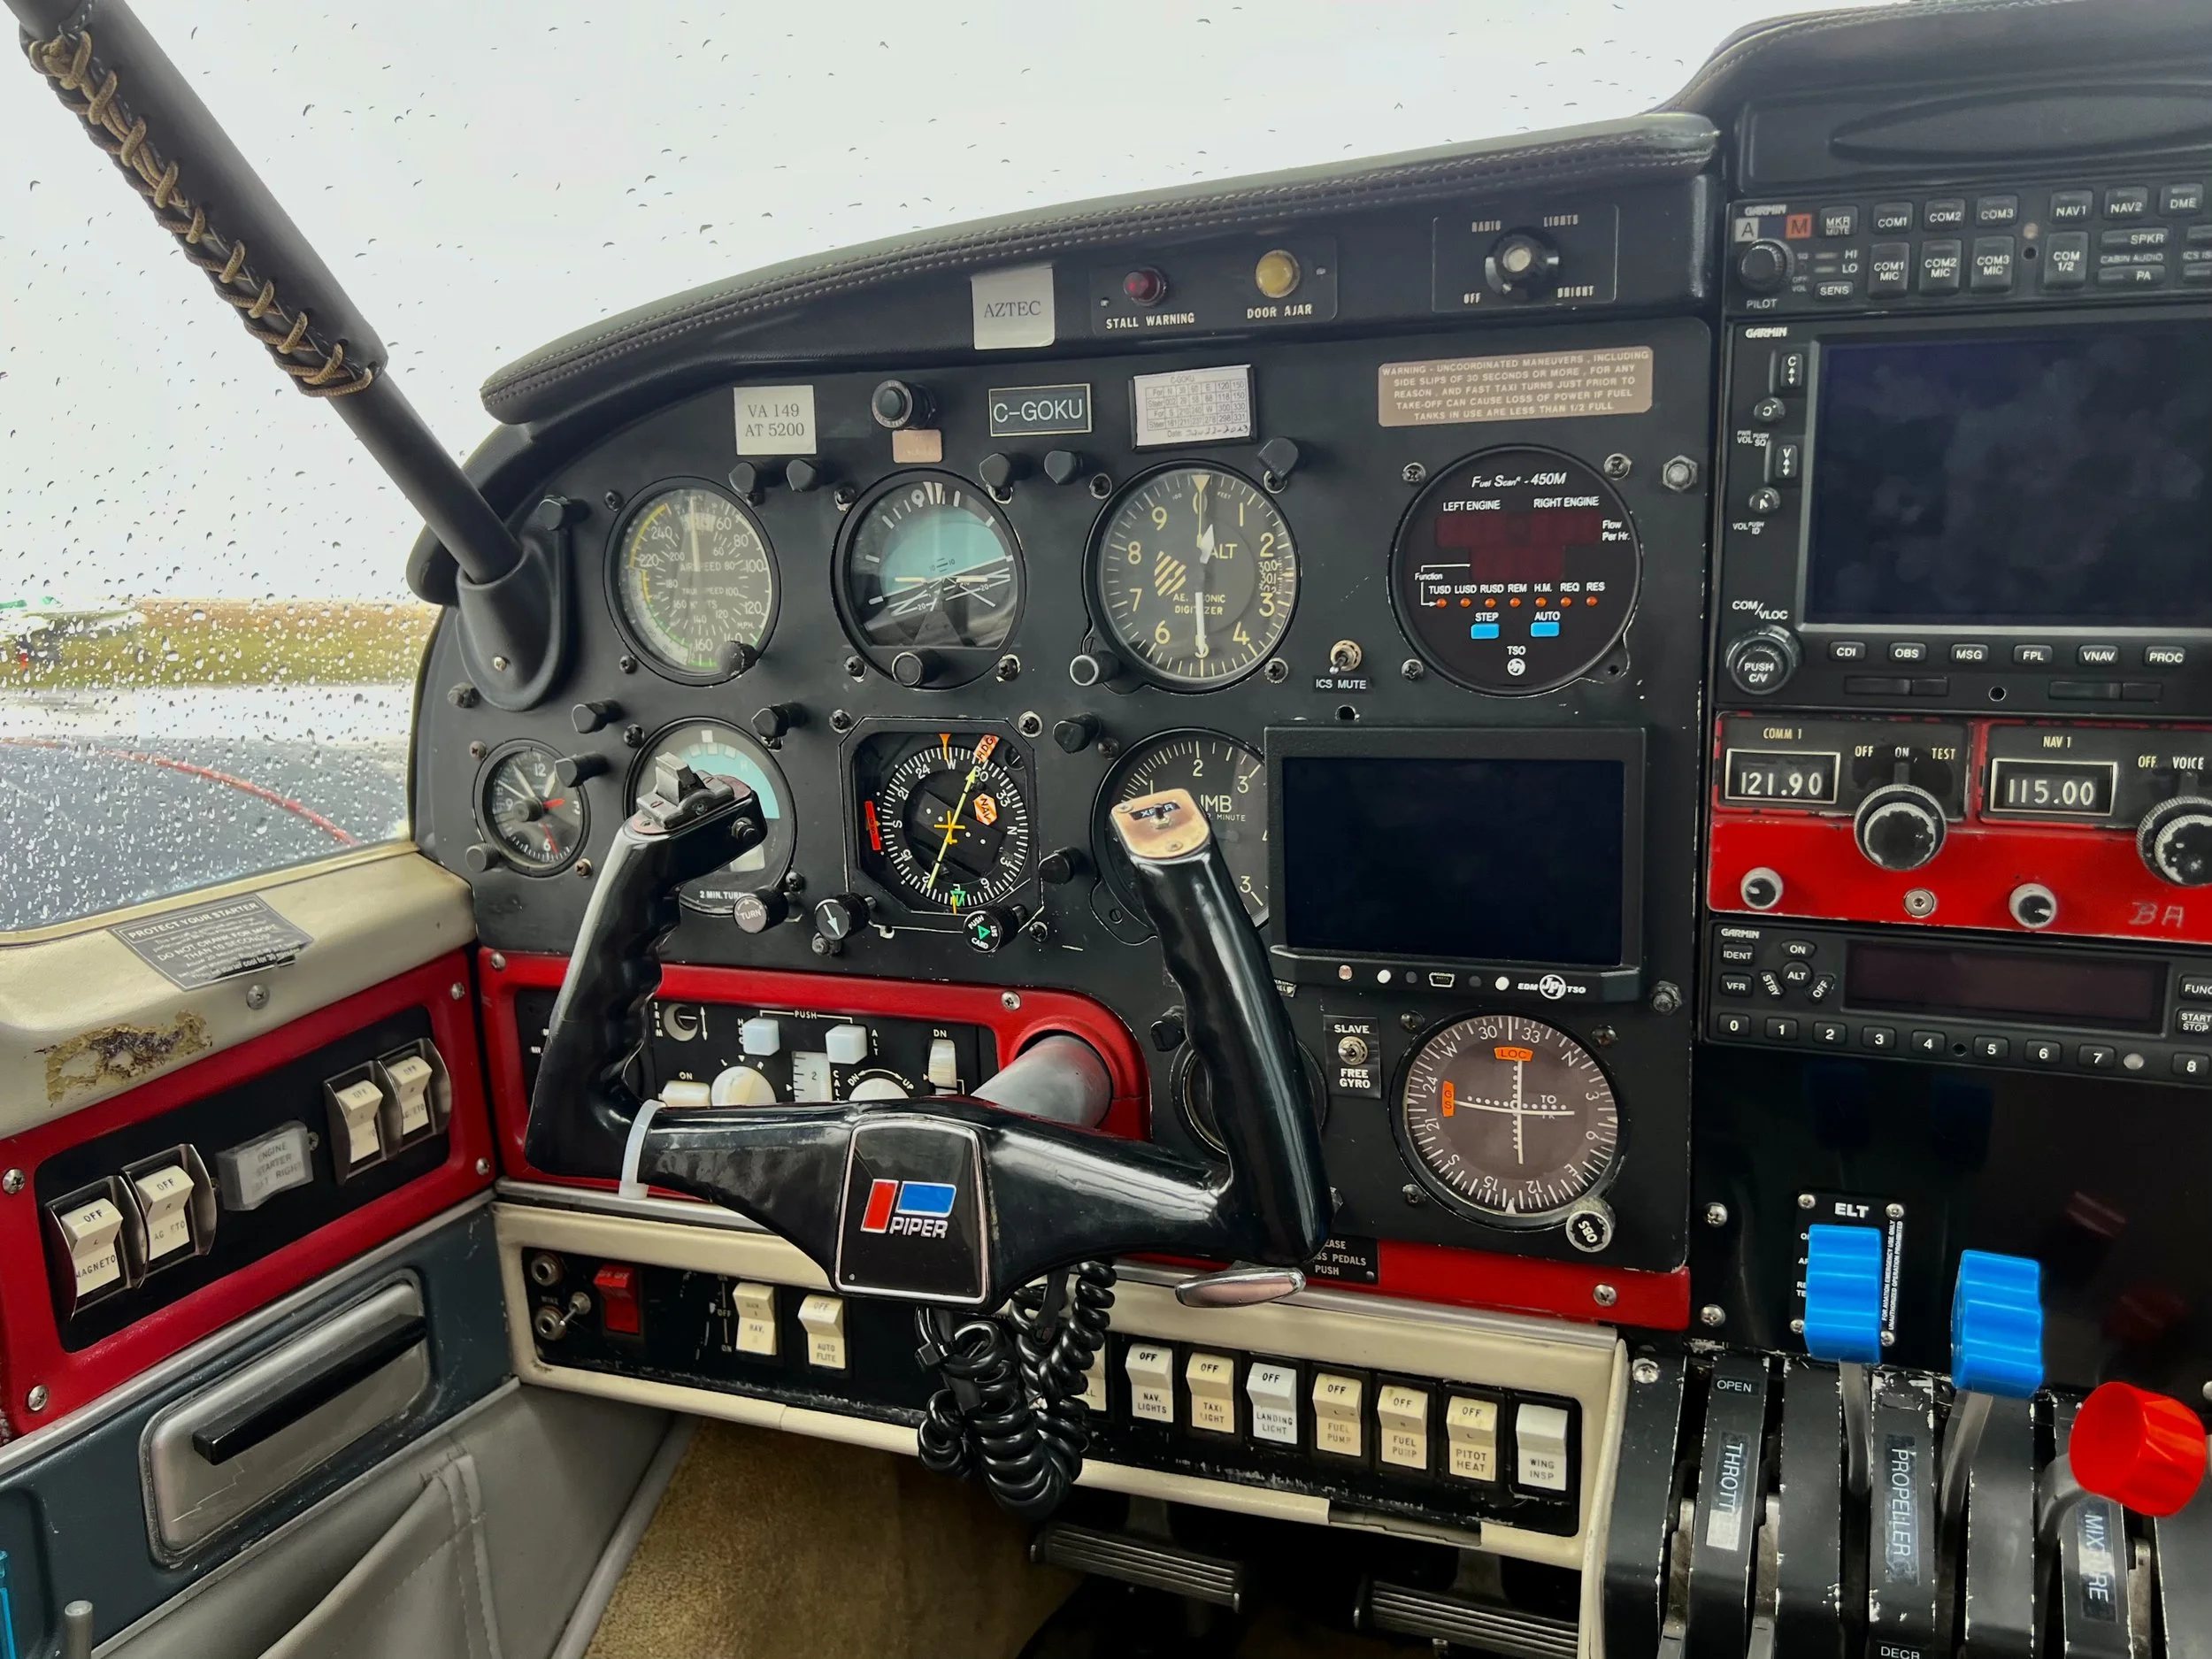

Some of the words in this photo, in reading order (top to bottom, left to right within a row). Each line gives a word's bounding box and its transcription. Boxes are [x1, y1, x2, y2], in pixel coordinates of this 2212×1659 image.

[2110, 202, 2142, 213] NAV2
[2170, 197, 2196, 209] DME
[1981, 209, 2014, 220] COM3
[2055, 203, 2087, 218] NAV1
[1544, 215, 1578, 227] LIGHTS
[1878, 217, 1908, 227] COM1
[1930, 211, 1962, 222] COM2
[1977, 255, 2009, 265] COM3
[2054, 250, 2080, 261] COM
[1874, 262, 1904, 272] COM1
[1924, 257, 1957, 268] COM2
[1931, 268, 1950, 278] MIC
[1983, 265, 2003, 275] MIC
[1879, 271, 1900, 281] MIC
[1820, 286, 1849, 296] SENS
[1463, 293, 1481, 303] OFF
[1747, 298, 1777, 309] PILOT
[984, 301, 1041, 318] AZTEC
[1247, 306, 1277, 319] DOOR
[1284, 304, 1312, 317] AJAR
[1106, 318, 1139, 329] STALL
[1146, 312, 1194, 326] WARNING
[1746, 327, 1787, 338] GARMIN
[1382, 365, 1426, 375] WARNING
[1594, 351, 1649, 362] INCLUDING
[1419, 376, 1446, 385] SLIPS
[1482, 371, 1529, 382] SECONDS
[1532, 370, 1547, 379] OR
[1550, 367, 1579, 377] MORE
[1590, 365, 1610, 375] FOR
[1615, 364, 1635, 373] ANY
[1394, 389, 1432, 398] REASON
[1495, 383, 1517, 393] TAXI
[1522, 381, 1554, 391] TURNS
[1557, 380, 1582, 388] JUST
[1586, 378, 1617, 387] PRIOR
[1621, 376, 1635, 385] TO
[1396, 400, 1443, 411] TAKE-OFF
[1470, 396, 1502, 405] CAUSE
[1506, 394, 1532, 403] LOSS
[1554, 391, 1590, 401] POWER
[1608, 389, 1632, 398] FUEL
[747, 404, 767, 418] VA
[773, 403, 799, 417] 149
[994, 399, 1082, 423] C-GOKU
[1415, 411, 1445, 421] TANKS
[1486, 408, 1506, 417] ARE
[1509, 405, 1535, 416] LESS
[1540, 404, 1566, 414] THAN
[1588, 403, 1614, 411] FULL
[745, 424, 764, 436] AT
[768, 423, 804, 436] 5200
[1471, 476, 1491, 488] Fuel
[1443, 502, 1463, 511] LEFT
[1466, 500, 1501, 510] ENGINE
[1533, 497, 1562, 508] RIGHT
[1564, 496, 1599, 507] ENGINE
[1602, 520, 1621, 529] Flow
[1602, 532, 1617, 541] Per
[1455, 585, 1477, 594] LUSD
[1480, 584, 1504, 593] RUSD
[1508, 584, 1527, 593] REM
[1560, 582, 1579, 592] REQ
[1586, 582, 1605, 591] RES
[1476, 612, 1498, 621] STEP
[1534, 611, 1560, 620] AUTO
[1507, 646, 1525, 655] TSO
[1836, 647, 1856, 657] CDI
[1894, 648, 1918, 658] OBS
[1955, 649, 1982, 659] MSG
[2023, 650, 2043, 661] FPL
[2083, 650, 2115, 662] VNAV
[2149, 651, 2183, 664] PROC
[1744, 662, 1774, 672] PUSH
[1749, 672, 1768, 682] C/V
[1316, 680, 1333, 688] ICS
[1338, 680, 1366, 689] MUTE
[1763, 727, 1793, 739] COMM
[977, 736, 995, 759] HDG
[2043, 735, 2063, 749] NAV
[1855, 746, 1874, 757] OFF
[1895, 747, 1909, 757] ON
[1932, 748, 1955, 760] TEST
[2138, 756, 2157, 768] OFF
[2172, 757, 2204, 770] VOICE
[1741, 772, 1822, 795] 121.90
[2008, 779, 2094, 806] 115.00
[979, 797, 994, 819] NAV
[128, 922, 180, 939] PROTECT
[181, 914, 211, 926] YOUR
[214, 902, 258, 918] STARTER
[740, 910, 762, 920] TURN
[967, 916, 984, 929] PUSH
[1721, 928, 1760, 939] GARMIN
[972, 938, 989, 949] CARD
[157, 952, 174, 961] DO
[176, 943, 196, 955] NOT
[1790, 945, 1806, 954] ON
[1763, 974, 1780, 996] STBY
[1812, 979, 1829, 998] OFF
[2182, 1013, 2211, 1023] START
[1334, 1025, 1369, 1034] SLAVE
[1479, 1025, 1498, 1040] 30
[1521, 1027, 1540, 1043] 33
[1502, 1049, 1526, 1059] LOC
[1340, 1069, 1369, 1079] FREE
[848, 1075, 859, 1087] DN
[902, 1079, 914, 1090] UP
[1340, 1078, 1371, 1089] GYRO
[1541, 1095, 1556, 1104] TO
[157, 1177, 175, 1190] OFF
[1835, 1202, 1869, 1217] ELT
[83, 1210, 103, 1223] OFF
[889, 1217, 949, 1239] PIPER
[1578, 1220, 1598, 1243] OBS
[1333, 1254, 1366, 1266] PEDALS
[1315, 1265, 1339, 1276] PUSH
[813, 1302, 830, 1310] OFF
[1140, 1353, 1157, 1362] OFF
[1201, 1363, 1218, 1372] OFF
[1263, 1373, 1280, 1383] OFF
[1327, 1385, 1347, 1394] OFF
[1717, 1380, 1752, 1392] OPEN
[1138, 1402, 1167, 1414] LIGHTS
[1394, 1398, 1412, 1408] OFF
[1463, 1407, 1482, 1417] OFF
[1256, 1412, 1293, 1425] LANDING
[1262, 1424, 1286, 1434] LIGHT
[1394, 1436, 1417, 1447] FUEL
[1455, 1449, 1486, 1461] PITOT
[1457, 1460, 1485, 1471] HEAT
[1530, 1459, 1555, 1469] WING
[1530, 1471, 1554, 1480] INSP
[1892, 1448, 1910, 1556] PROPELLER
